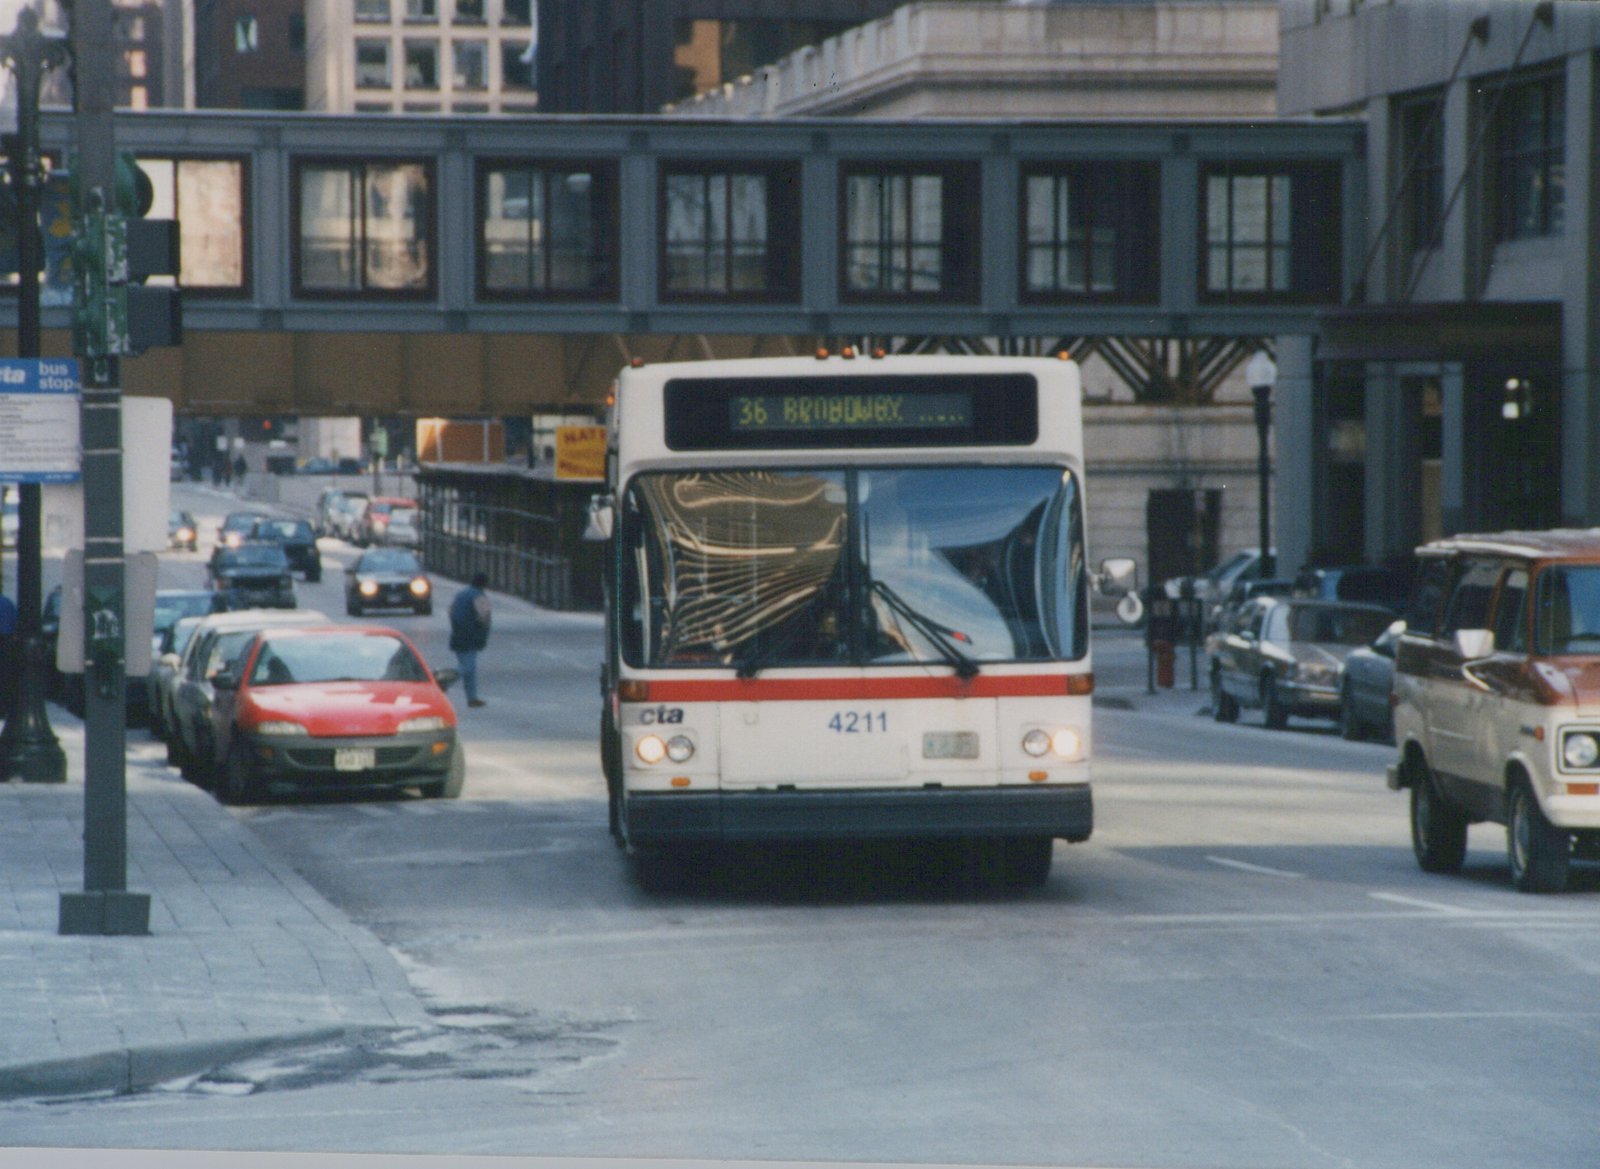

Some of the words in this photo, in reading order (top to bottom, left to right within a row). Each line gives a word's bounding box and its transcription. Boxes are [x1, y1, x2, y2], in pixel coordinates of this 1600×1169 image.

[38, 361, 69, 376] bus
[38, 376, 74, 392] stop
[738, 397, 768, 425] 36
[639, 704, 684, 725] cta
[828, 711, 887, 733] 4211
